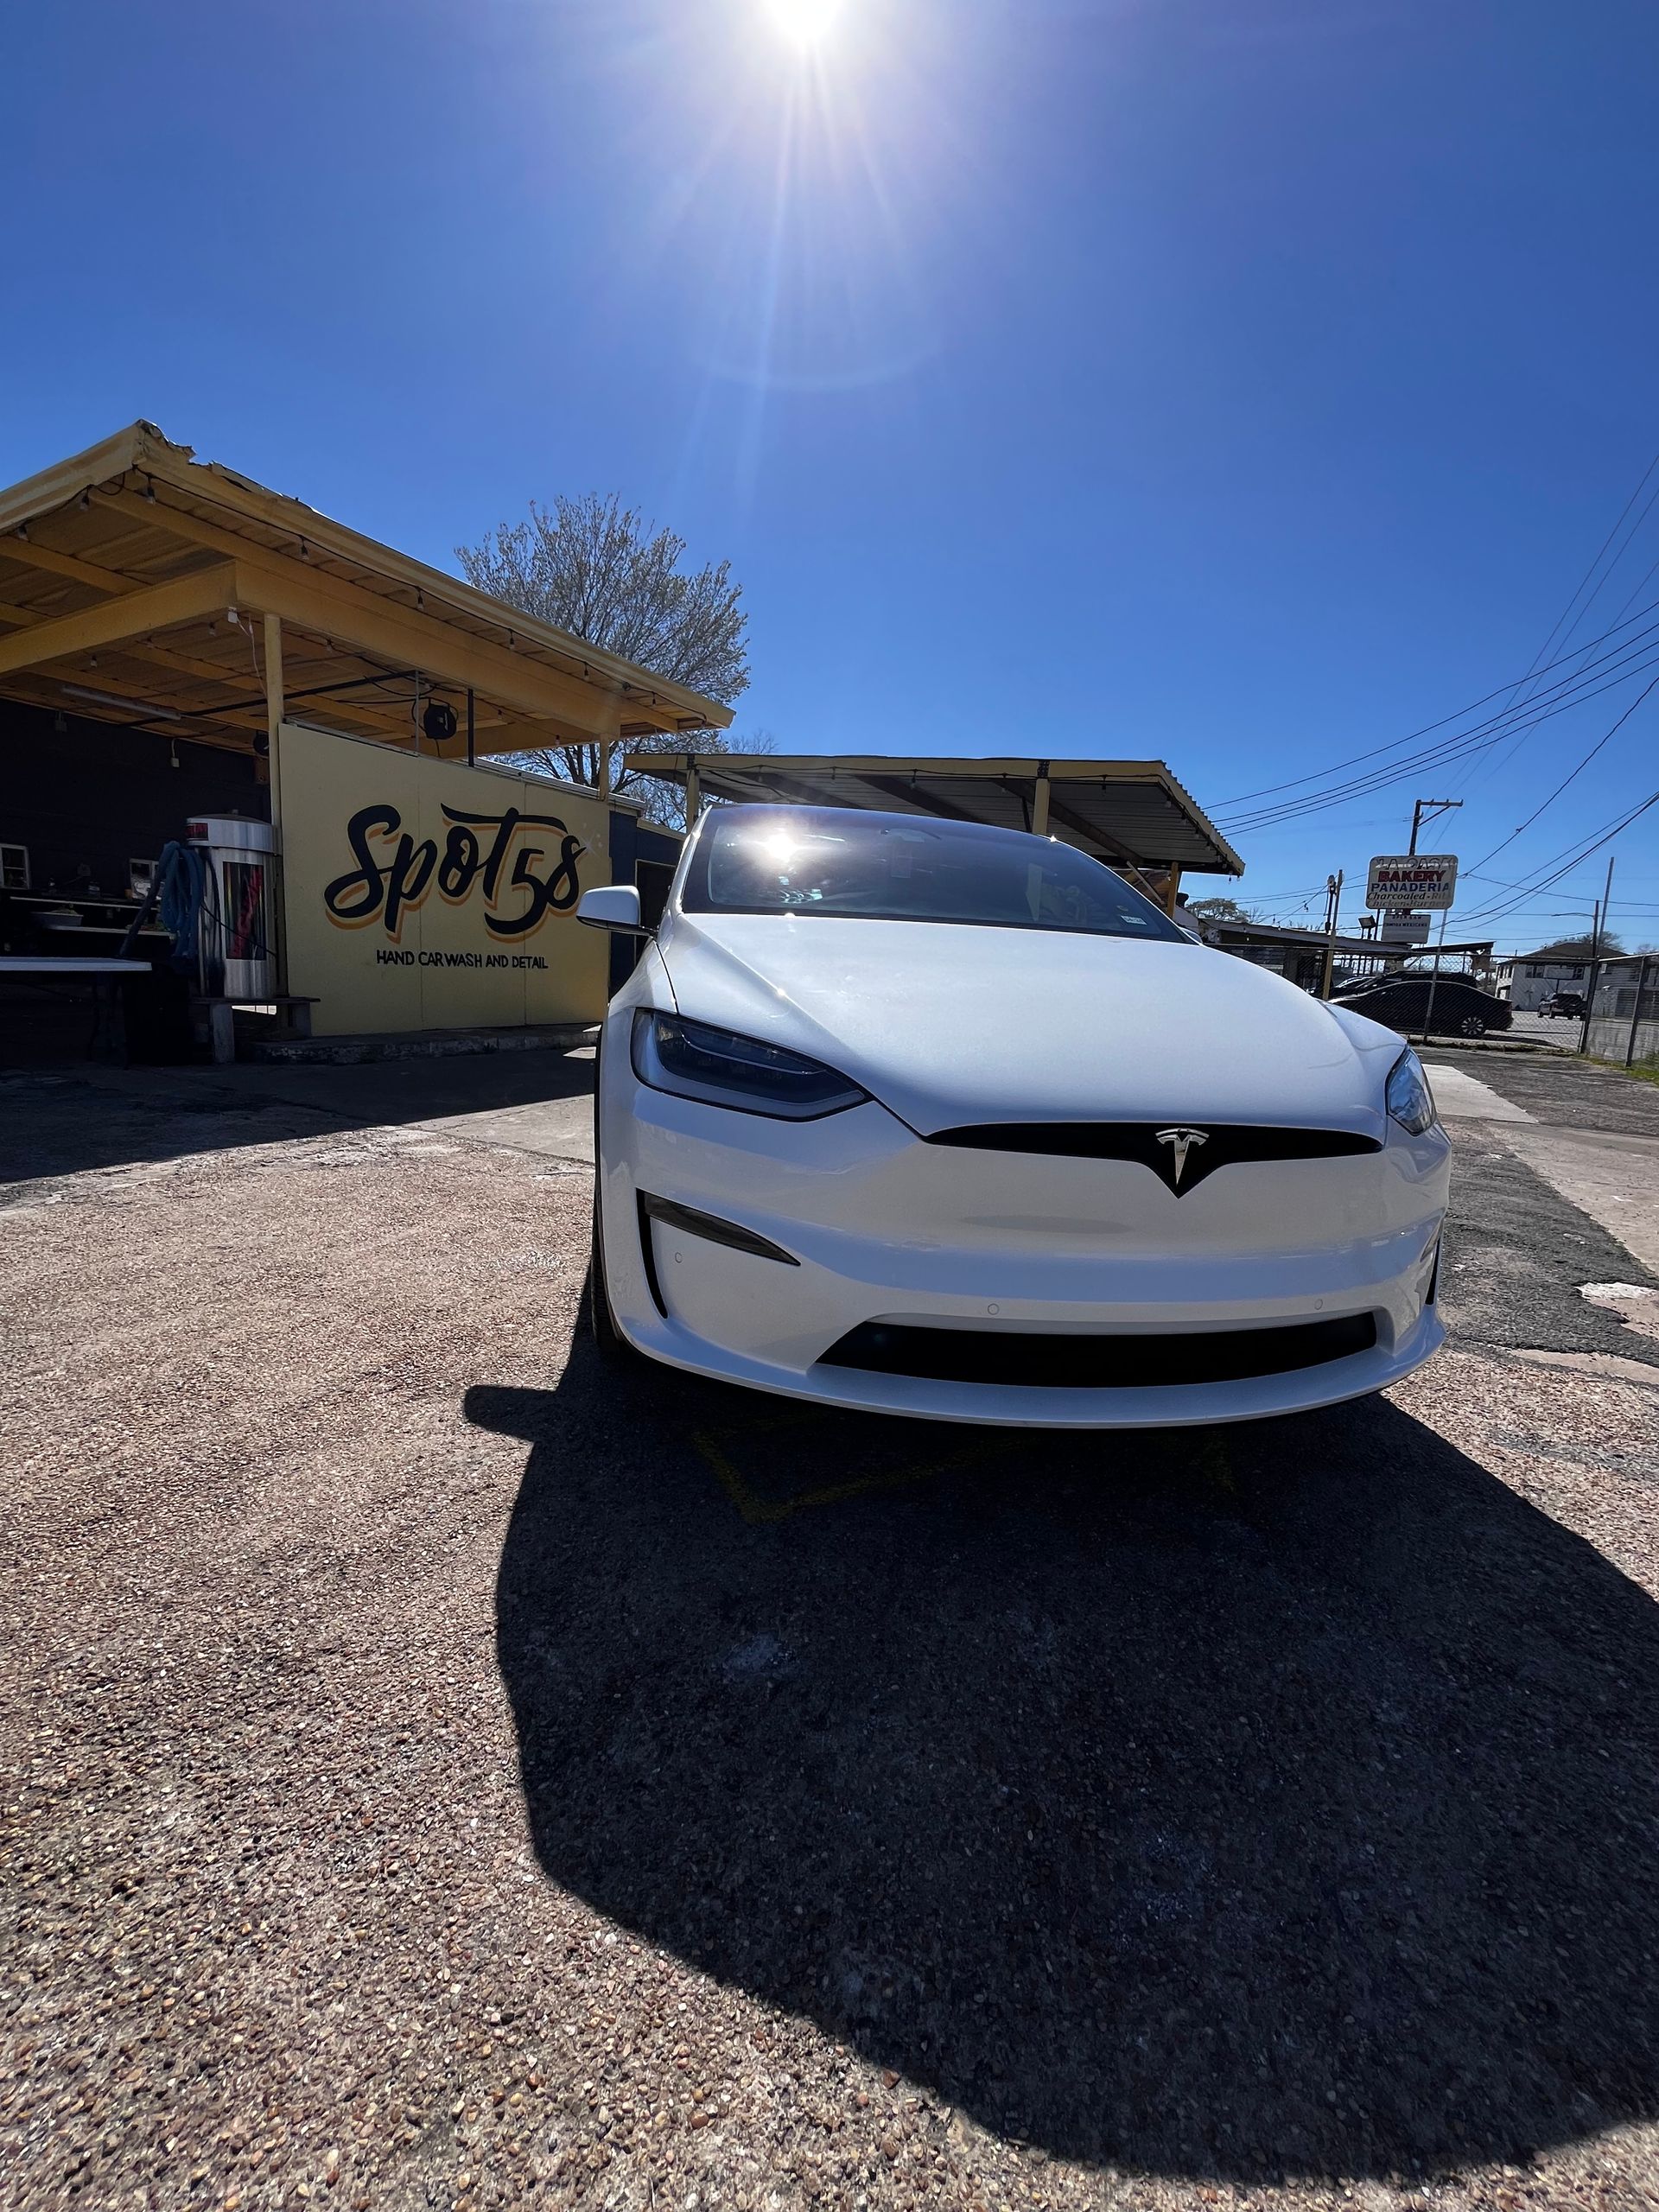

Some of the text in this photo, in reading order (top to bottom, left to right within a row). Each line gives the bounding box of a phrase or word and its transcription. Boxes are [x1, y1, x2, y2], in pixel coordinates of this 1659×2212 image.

[1377, 870, 1446, 882] BAKERY
[1370, 882, 1450, 893] PANADERIA
[377, 950, 549, 969] HAND CAR WASH AND DETAIL
